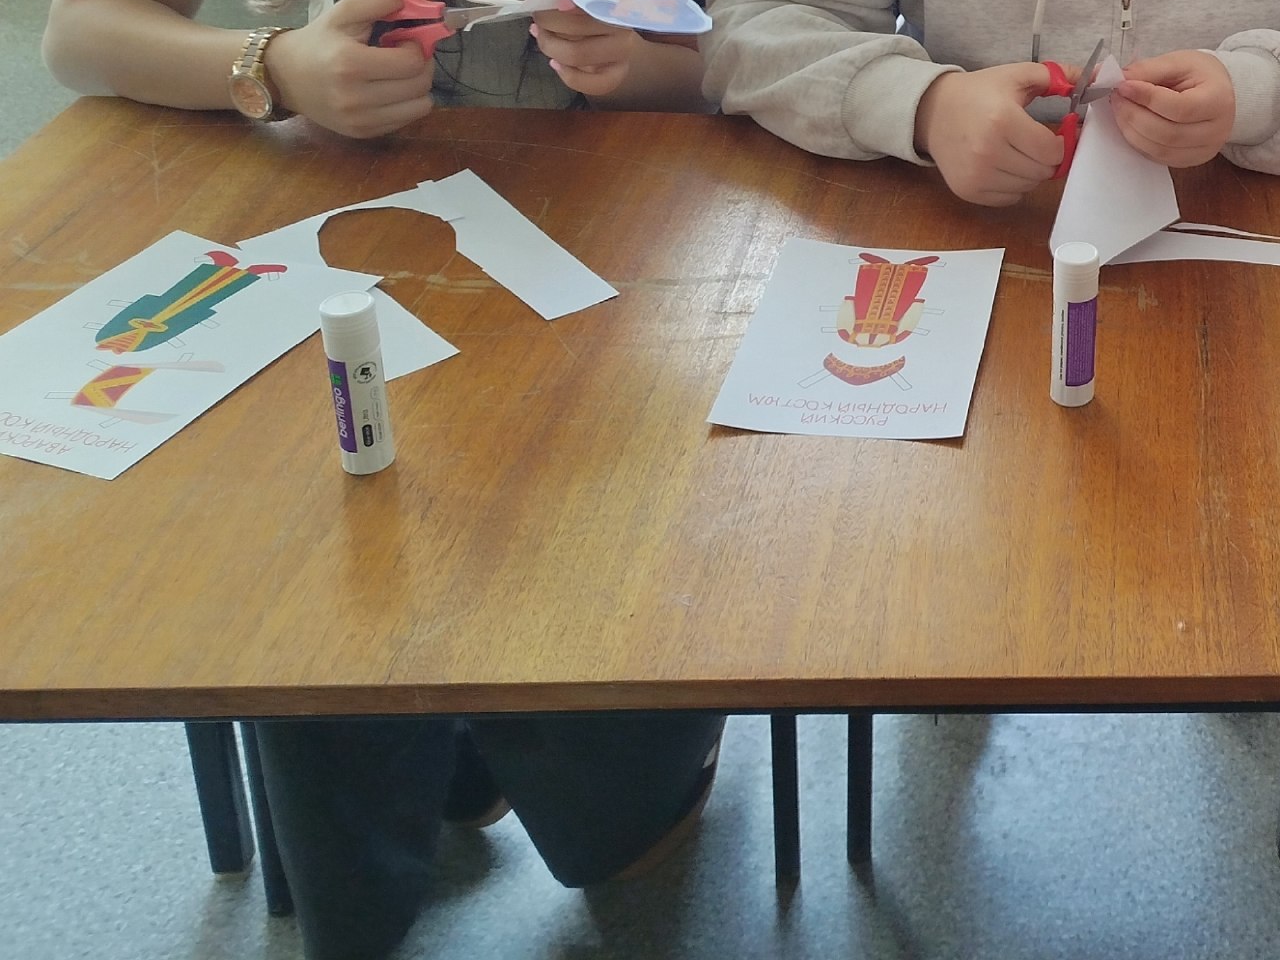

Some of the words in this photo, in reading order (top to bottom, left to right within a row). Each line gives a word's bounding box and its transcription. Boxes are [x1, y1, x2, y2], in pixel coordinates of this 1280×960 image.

[749, 393, 834, 412] КОСТЮМ
[837, 400, 948, 415] НАРОДНЫЙ
[333, 387, 348, 438] berlingo
[800, 413, 889, 427] РУССКИЙ
[30, 422, 138, 454] НАРОДНЫЙ
